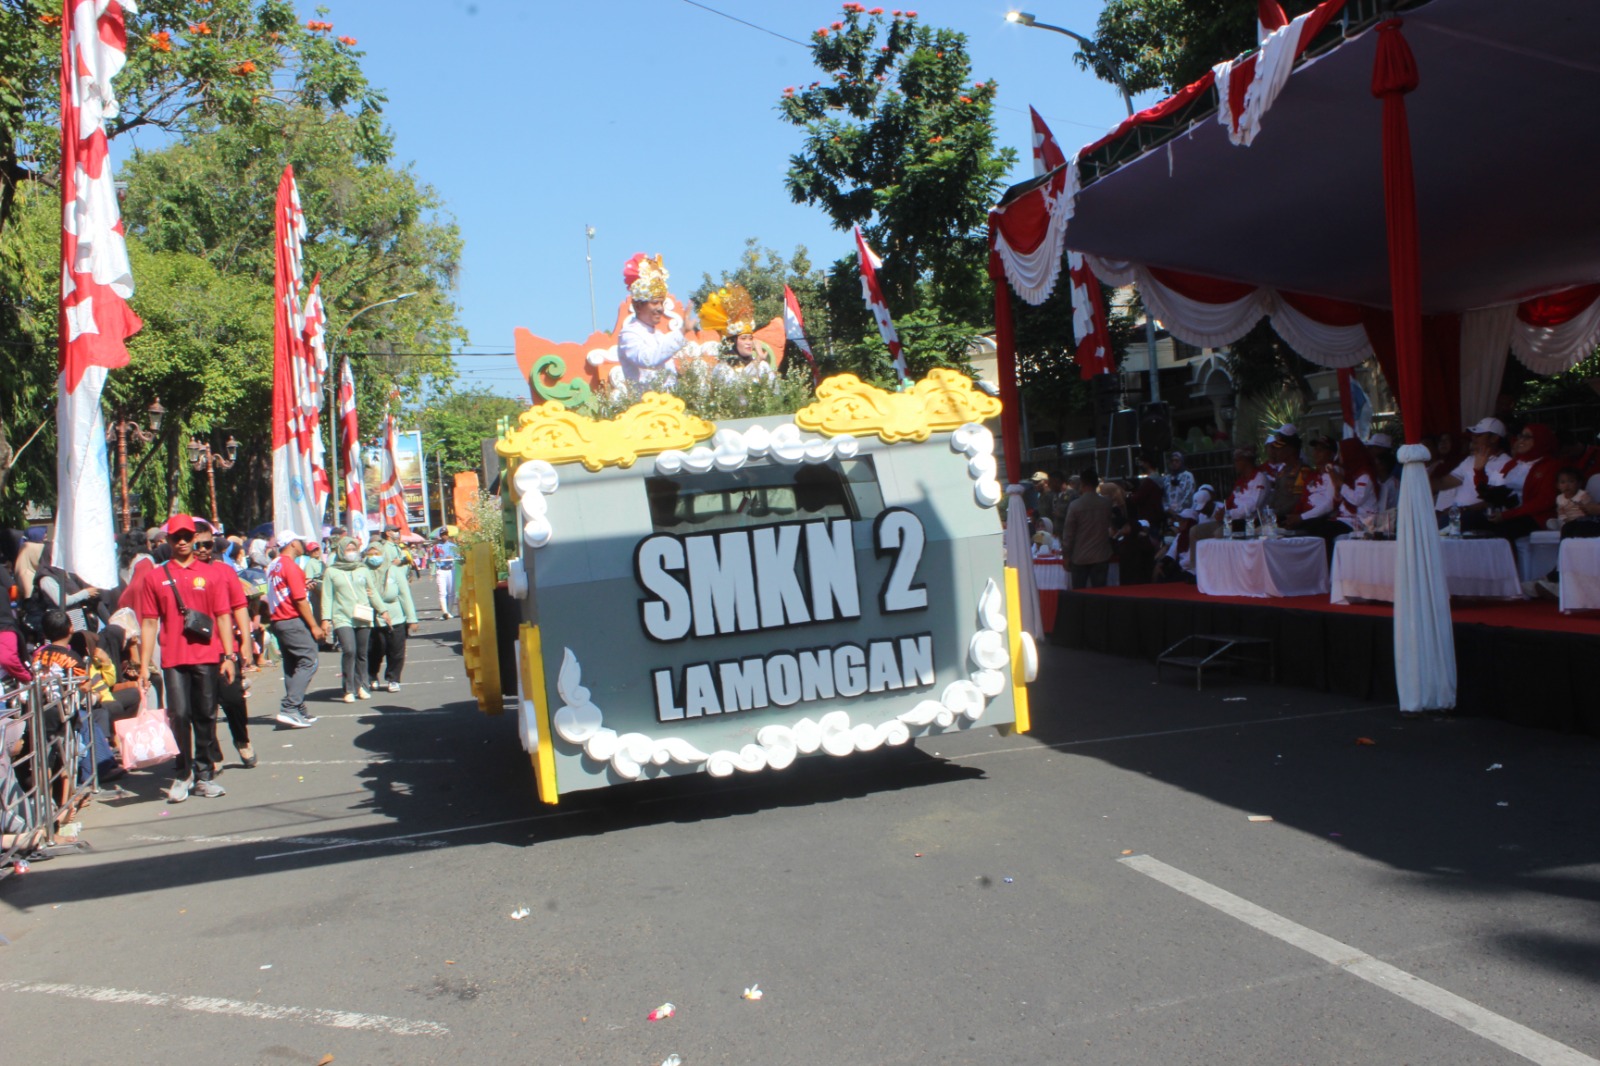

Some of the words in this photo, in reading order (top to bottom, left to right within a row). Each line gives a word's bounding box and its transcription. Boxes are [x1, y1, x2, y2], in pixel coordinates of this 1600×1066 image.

[637, 518, 861, 642] SMKN
[879, 509, 929, 612] 2
[653, 635, 935, 721] LAMONGAN
